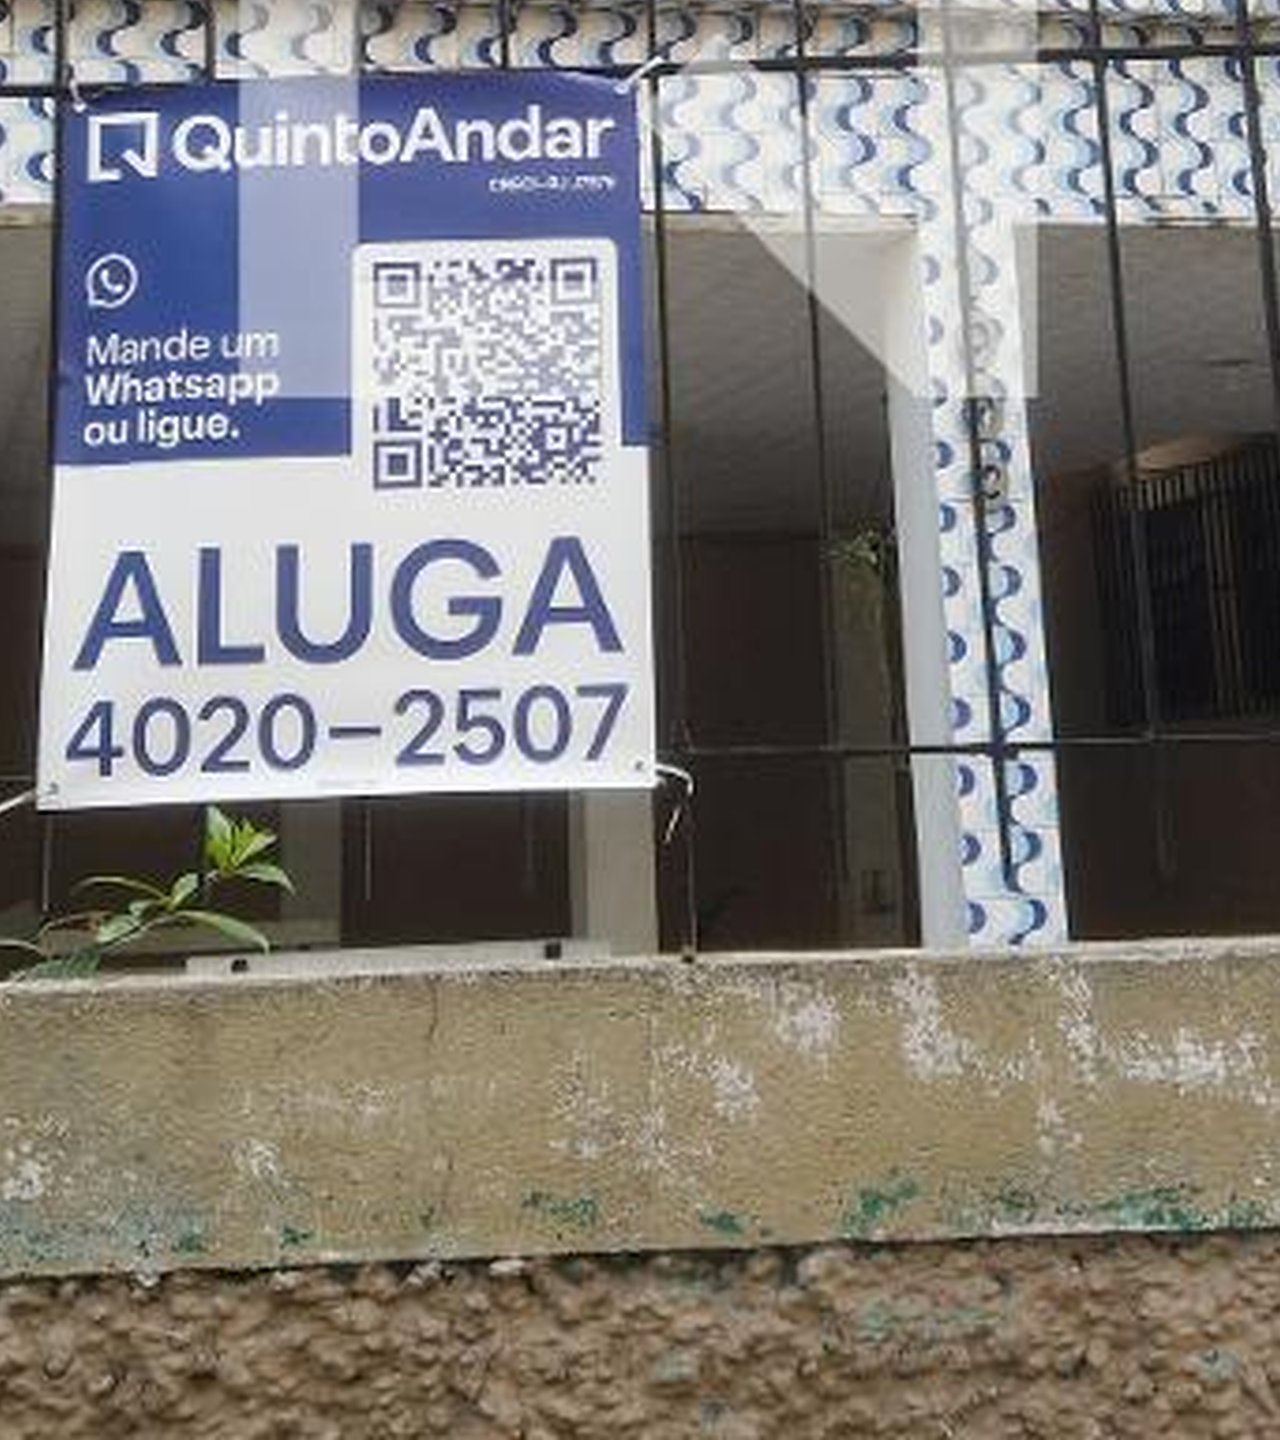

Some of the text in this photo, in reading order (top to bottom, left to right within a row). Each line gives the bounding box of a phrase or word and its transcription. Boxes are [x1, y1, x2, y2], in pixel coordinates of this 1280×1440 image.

[172, 106, 614, 172] QuintoAndar
[86, 327, 279, 365] Mande um
[84, 371, 280, 408] Whatsapp
[83, 410, 240, 449] ou ligue.
[72, 536, 625, 671] ALUGA
[64, 683, 630, 777] 4020-2507
